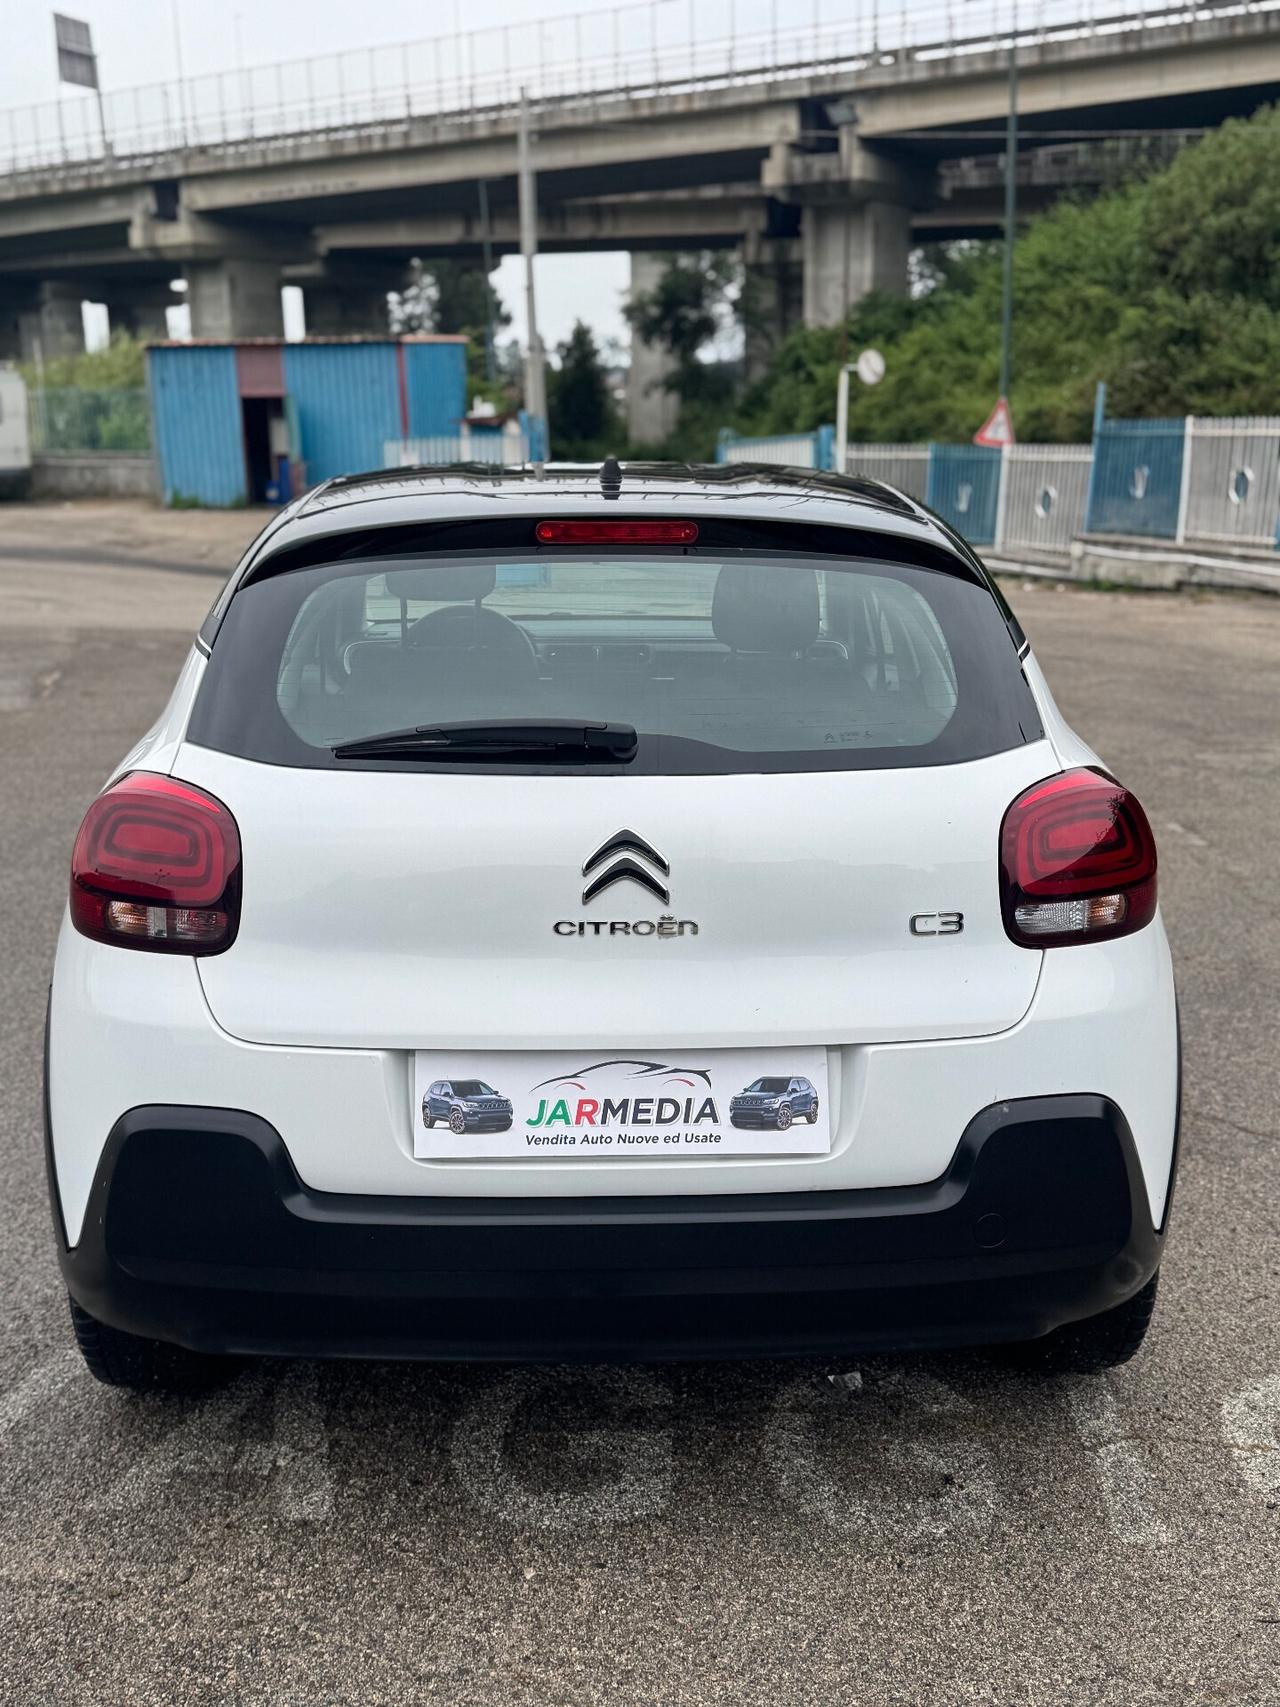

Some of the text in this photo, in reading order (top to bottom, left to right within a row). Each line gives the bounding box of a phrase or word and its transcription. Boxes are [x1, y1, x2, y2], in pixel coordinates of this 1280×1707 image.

[910, 912, 964, 935] C3
[526, 1097, 720, 1127] JARMEDIA
[525, 1132, 721, 1145] Vendita Auto Nuove ed Usate
